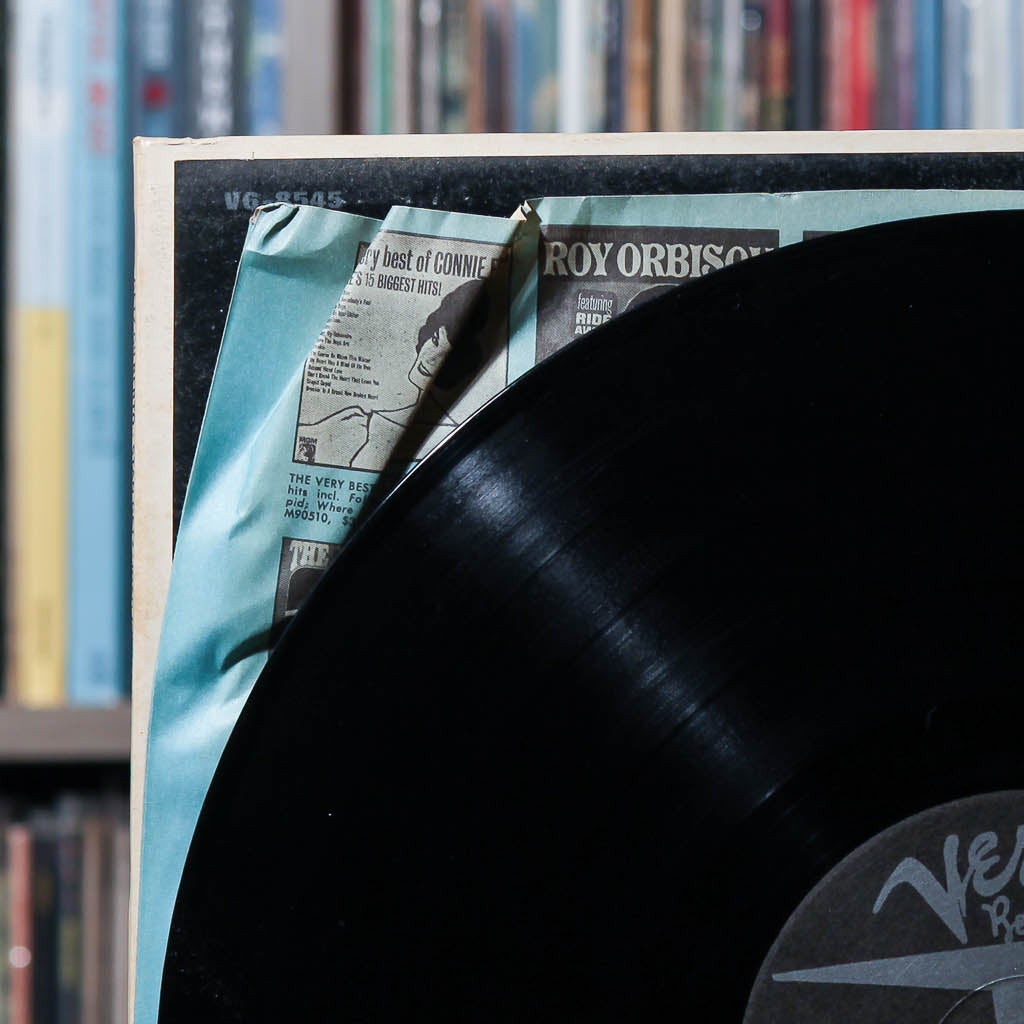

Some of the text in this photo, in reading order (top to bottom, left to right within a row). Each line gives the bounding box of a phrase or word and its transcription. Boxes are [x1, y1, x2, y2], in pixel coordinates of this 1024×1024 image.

[383, 245, 413, 271] best
[416, 250, 432, 274] of
[434, 252, 489, 280] CONNIE
[543, 241, 614, 277] ROY
[365, 273, 375, 287] 15
[377, 274, 417, 294] BIGGEST
[417, 280, 442, 296] HITS!
[577, 293, 613, 318] featuring
[574, 325, 596, 335] AW
[289, 473, 311, 485] THE
[315, 476, 345, 489] VERY
[287, 485, 308, 497] hits
[317, 489, 340, 501] incl.
[284, 508, 331, 525] M90510,
[317, 501, 354, 515] Where
